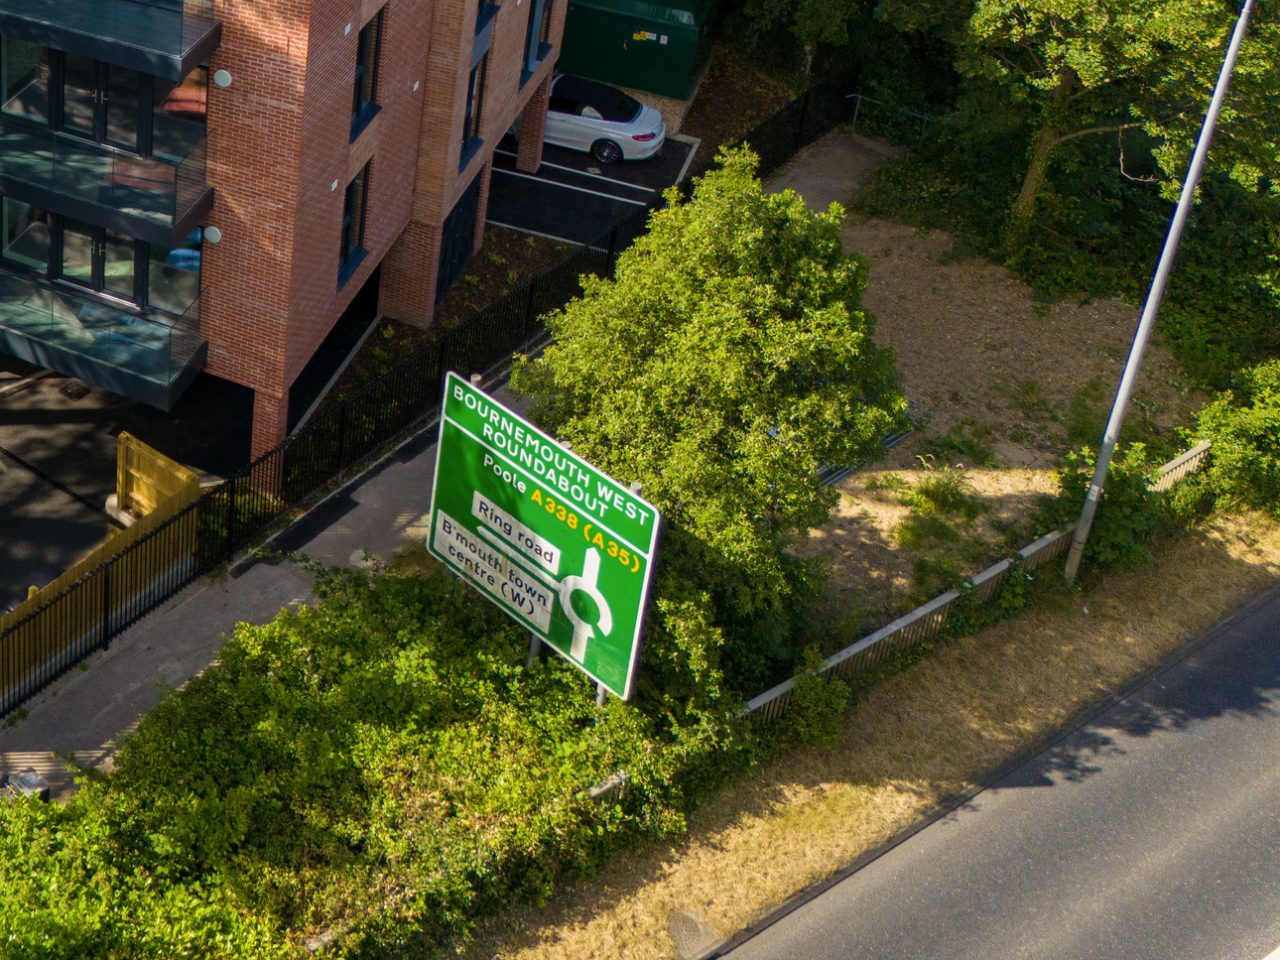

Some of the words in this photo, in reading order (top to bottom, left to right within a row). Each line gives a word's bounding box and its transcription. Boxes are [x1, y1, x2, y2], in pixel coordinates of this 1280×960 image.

[453, 385, 589, 487] BOURNEMOUTH
[597, 482, 649, 525] WEST
[483, 424, 608, 517] ROUNDABOUT
[479, 501, 512, 536] Ring
[518, 532, 553, 564] road
[484, 454, 526, 494] Poole
[531, 489, 578, 529] A338
[583, 524, 640, 573] (A35)
[442, 520, 502, 573] B'mouth
[508, 569, 546, 606] town
[448, 546, 495, 585] centre
[501, 582, 534, 615] (W)
